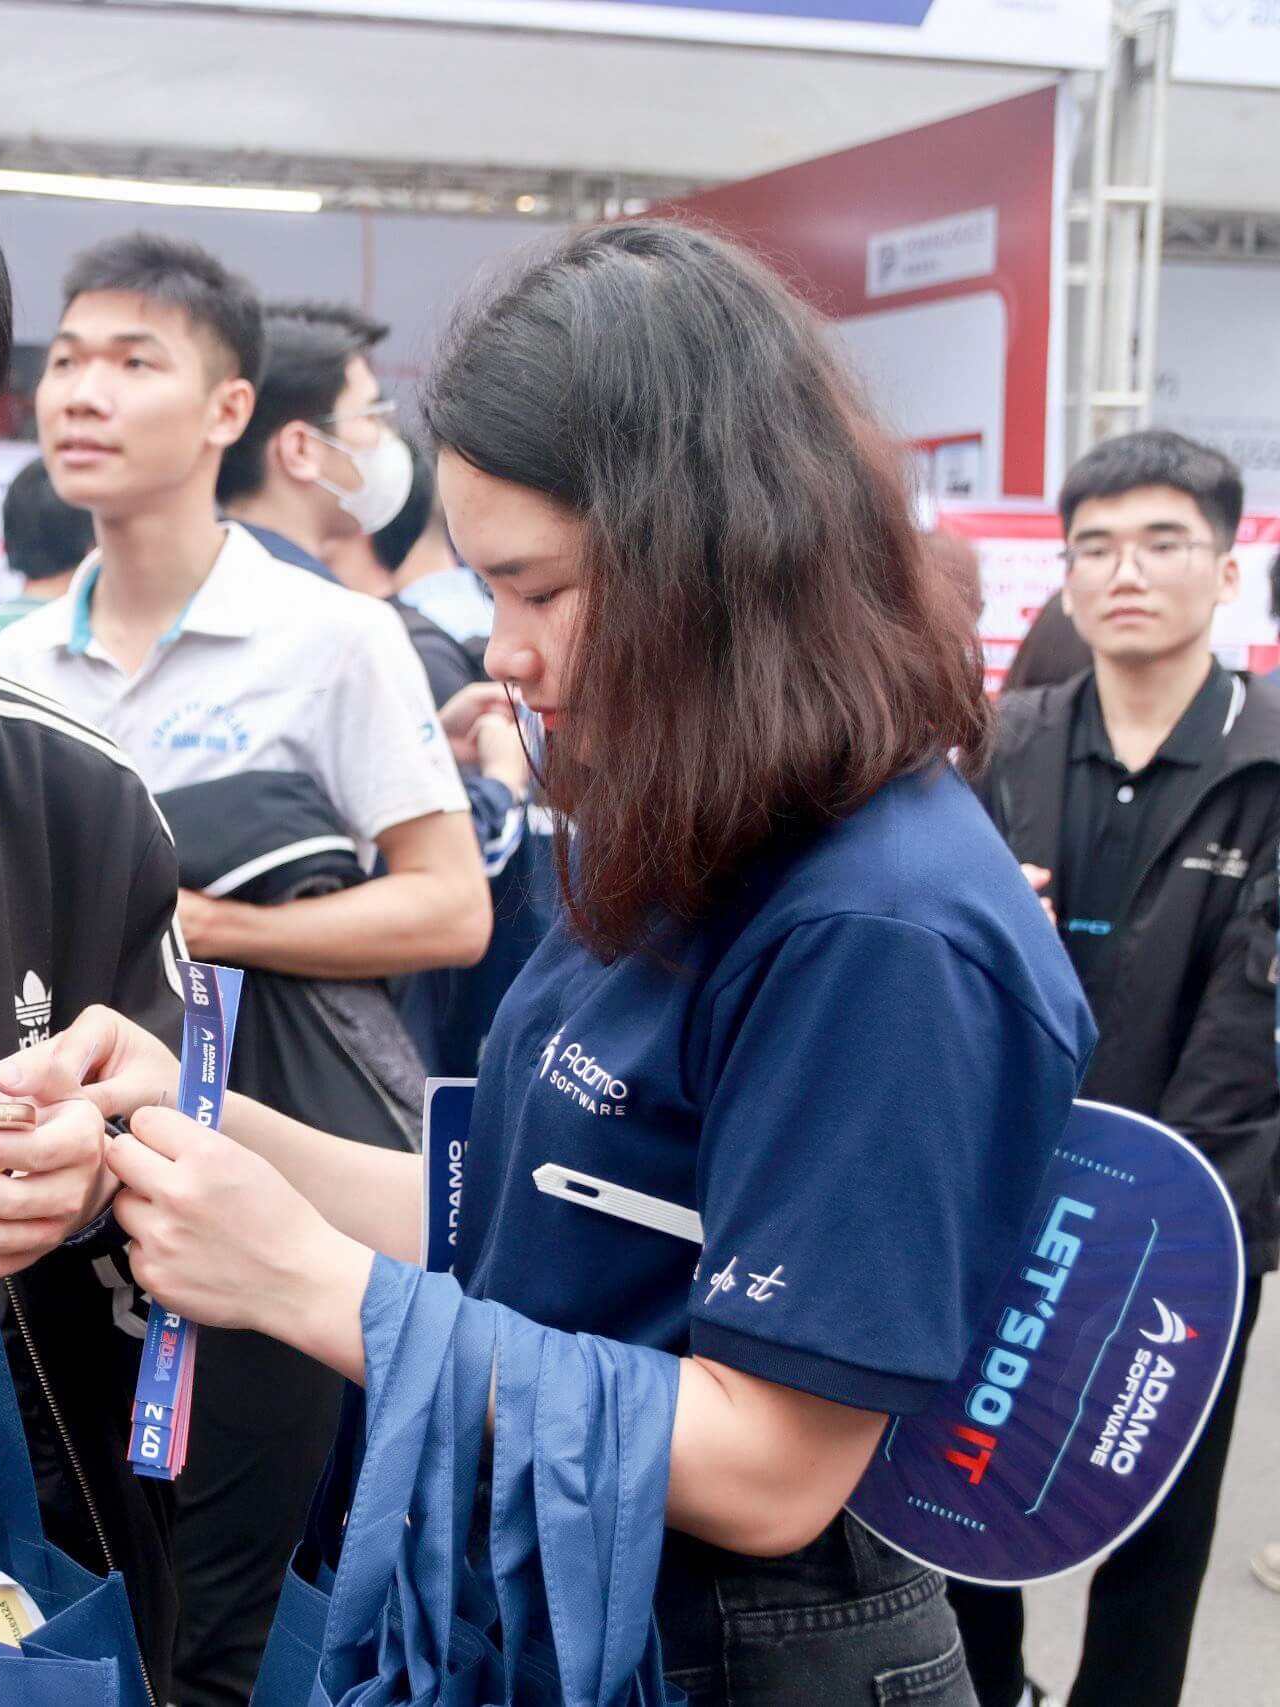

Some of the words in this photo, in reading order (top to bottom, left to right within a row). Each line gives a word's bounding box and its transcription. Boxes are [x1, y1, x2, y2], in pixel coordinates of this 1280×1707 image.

[188, 965, 210, 1007] 448
[207, 1043, 216, 1084] ADAMO
[559, 1043, 628, 1100] Adamo
[197, 1095, 214, 1127] AD
[549, 1069, 626, 1116] SOFTWARE
[704, 1256, 736, 1304] do
[746, 1264, 786, 1301] it
[154, 1330, 178, 1382] 2024
[1090, 1348, 1153, 1467] SOFTWARE
[1110, 1353, 1176, 1476] ADAMO
